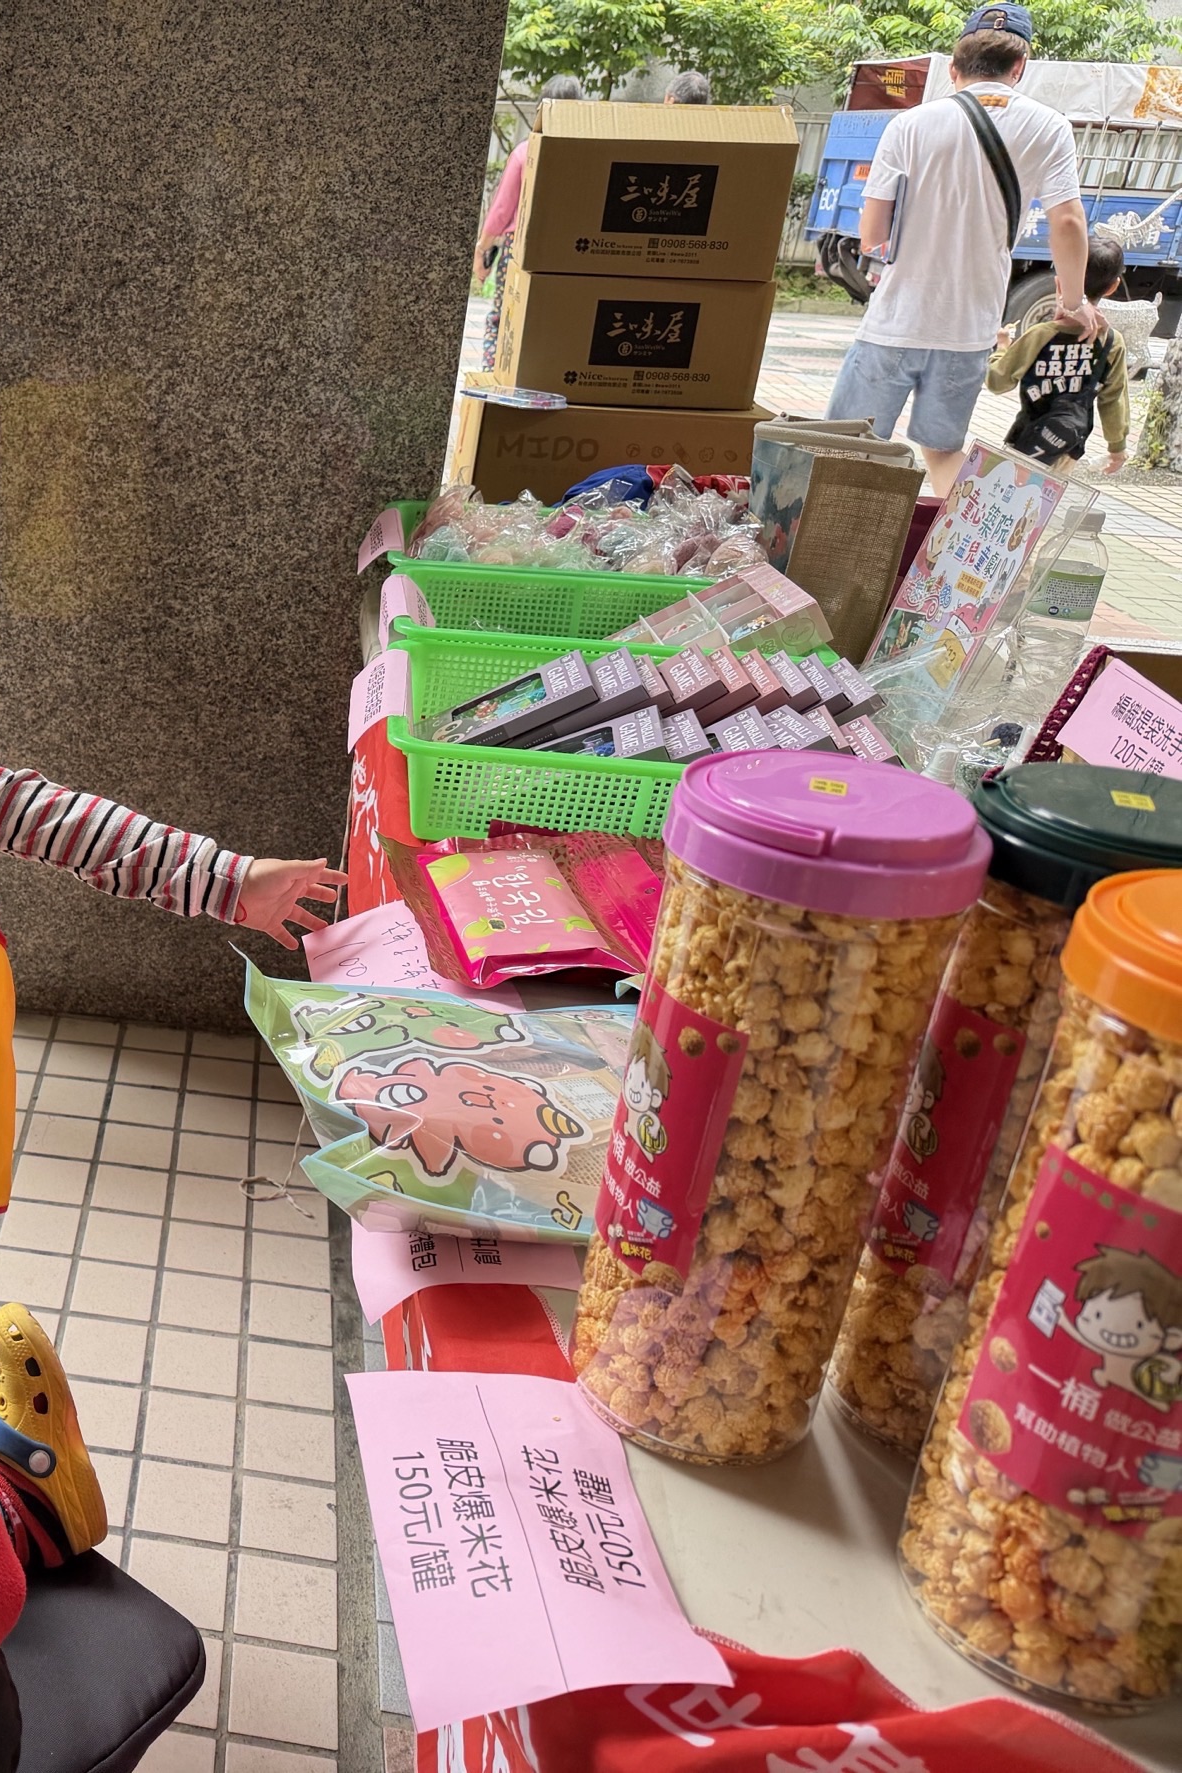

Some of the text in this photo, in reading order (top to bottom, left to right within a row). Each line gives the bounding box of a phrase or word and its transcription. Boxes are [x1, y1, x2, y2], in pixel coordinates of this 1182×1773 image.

[620, 174, 702, 209] 三味屋
[591, 238, 616, 249] Nice
[660, 239, 729, 251] 0908-568-830
[606, 311, 684, 343] 三味屋
[1049, 344, 1094, 361] THE
[579, 371, 602, 382] Nice
[645, 371, 710, 383] 0908-568-830
[1035, 359, 1098, 377] GREA
[496, 434, 599, 462] MIDO
[547, 666, 568, 693] GAME
[566, 658, 582, 685] PINBALL
[595, 665, 615, 692] GAME
[616, 657, 631, 684] PINBALL
[639, 664, 658, 691] PINBALL
[669, 662, 691, 692] GAME
[685, 653, 708, 681] PINBALL
[717, 658, 736, 684] PINBALL
[747, 661, 765, 688] PINBALL
[777, 660, 798, 687] PINBALL
[806, 664, 826, 693] PINBALL
[619, 722, 639, 750] GAME
[639, 717, 655, 744] PINBALL
[676, 718, 698, 747] PINBALL
[741, 718, 762, 747] PINBALL
[780, 715, 812, 741] PINBALL
[856, 726, 882, 756] PINBALL
[1111, 693, 1182, 766] 編織提袋洗手
[1028, 1362, 1103, 1422] 一桶
[1013, 1402, 1132, 1479] 幫助植物人
[393, 1451, 456, 1593] 150元/罐
[436, 1438, 513, 1598] 脆皮爆米花
[521, 1445, 606, 1594] 脆皮爆米花
[573, 1467, 647, 1589] 150元/罐
